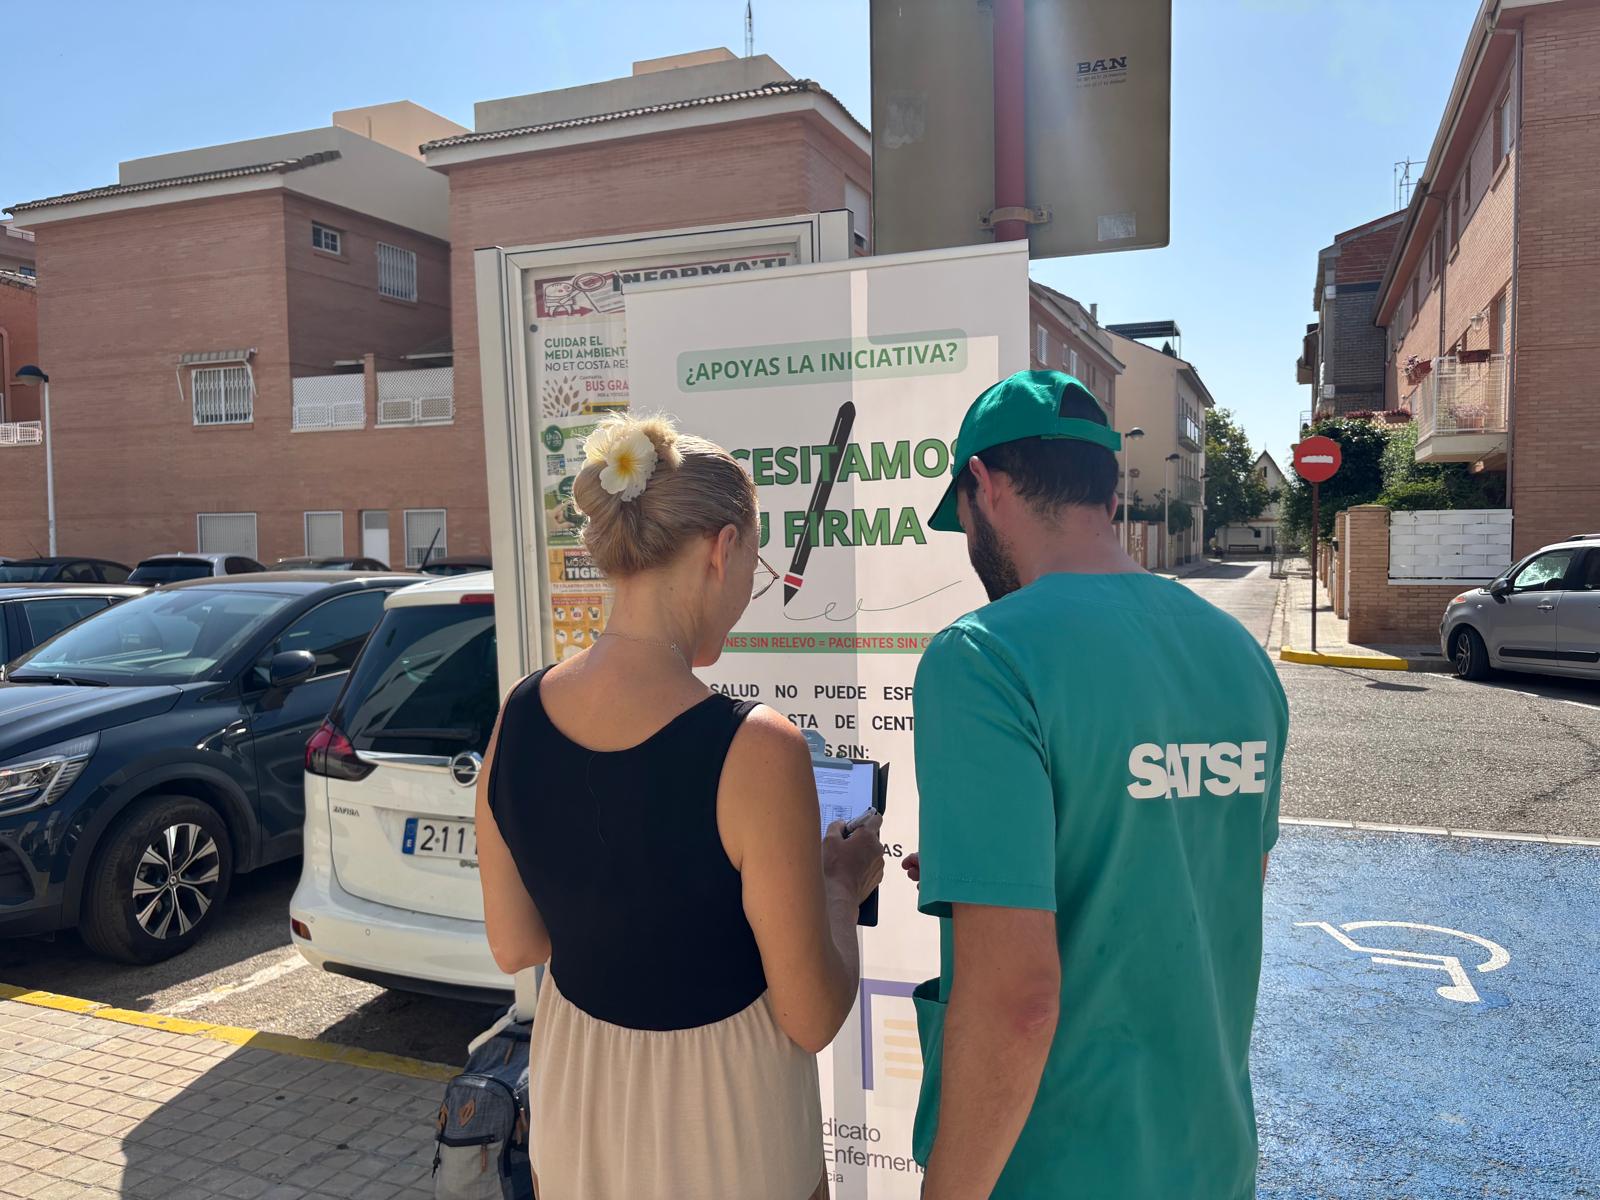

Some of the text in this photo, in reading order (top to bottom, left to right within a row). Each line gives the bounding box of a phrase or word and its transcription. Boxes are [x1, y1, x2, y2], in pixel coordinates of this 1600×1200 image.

[544, 336, 603, 348] CUIDAR EL
[544, 346, 627, 360] MEDI AMBIENT
[545, 362, 561, 372] NO
[562, 361, 575, 371] ET
[577, 360, 611, 370] COSTA
[685, 342, 958, 386] ¿APOYAS LA INICIATIVA?
[585, 380, 605, 391] BUS
[730, 438, 958, 487] ESITAMO
[784, 507, 928, 548] FIRMA
[750, 637, 769, 648] SIN
[772, 636, 815, 648] RELEVO
[829, 636, 893, 649] PACIENTES
[897, 637, 918, 649] SIN
[710, 683, 760, 698] SALUD
[775, 685, 798, 699] NO
[814, 685, 867, 699] PUEDE
[835, 714, 856, 729] DE
[837, 744, 870, 759] SIN:
[1126, 740, 1267, 799] SATSE
[420, 825, 478, 855] 211
[822, 1117, 881, 1143] dicato
